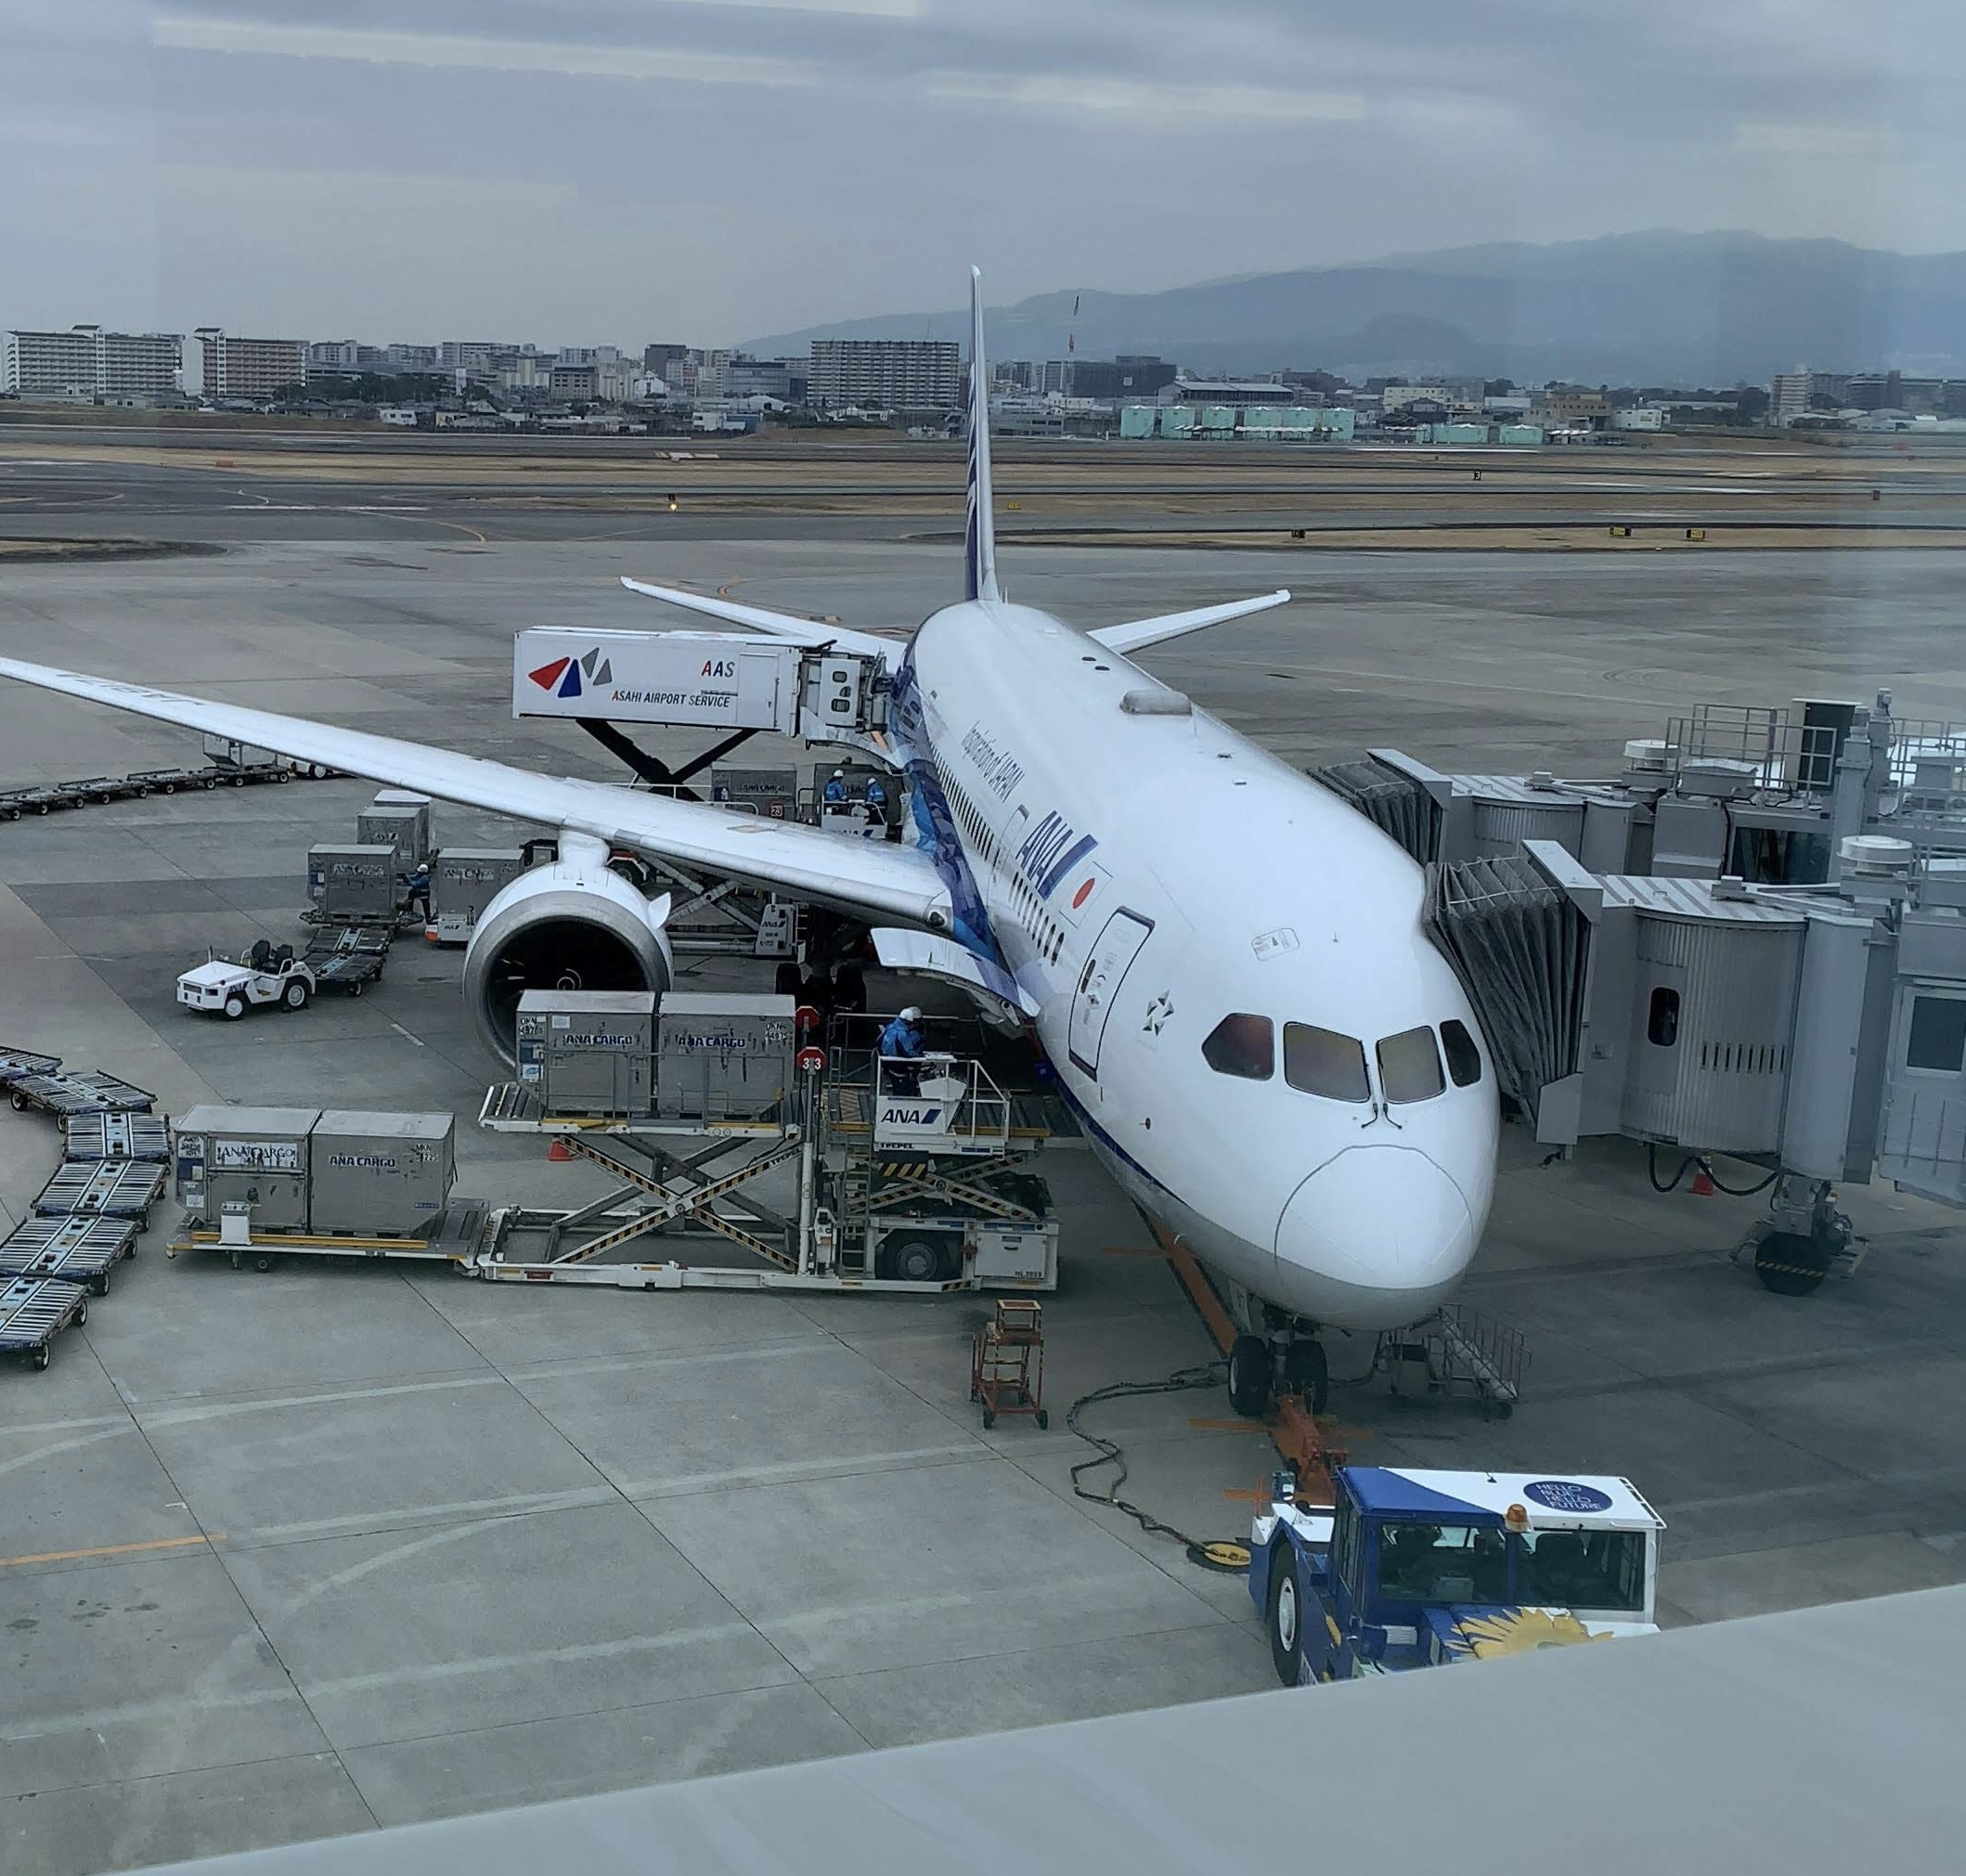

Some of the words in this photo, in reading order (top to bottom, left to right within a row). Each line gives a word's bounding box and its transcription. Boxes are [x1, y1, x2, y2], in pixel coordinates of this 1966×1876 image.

[701, 660, 735, 678] AAS
[612, 690, 642, 703] ASAHI
[643, 692, 687, 705] AIRPORT
[688, 695, 731, 707] SERVICE
[1015, 809, 1074, 888] ANA
[565, 1035, 591, 1045] ANA
[593, 1035, 633, 1045] CARGO
[679, 1037, 704, 1046] ANA
[705, 1037, 745, 1047] CARGO
[881, 1108, 920, 1124] ANA
[330, 1156, 355, 1166] ANA
[356, 1157, 396, 1168] CARGO
